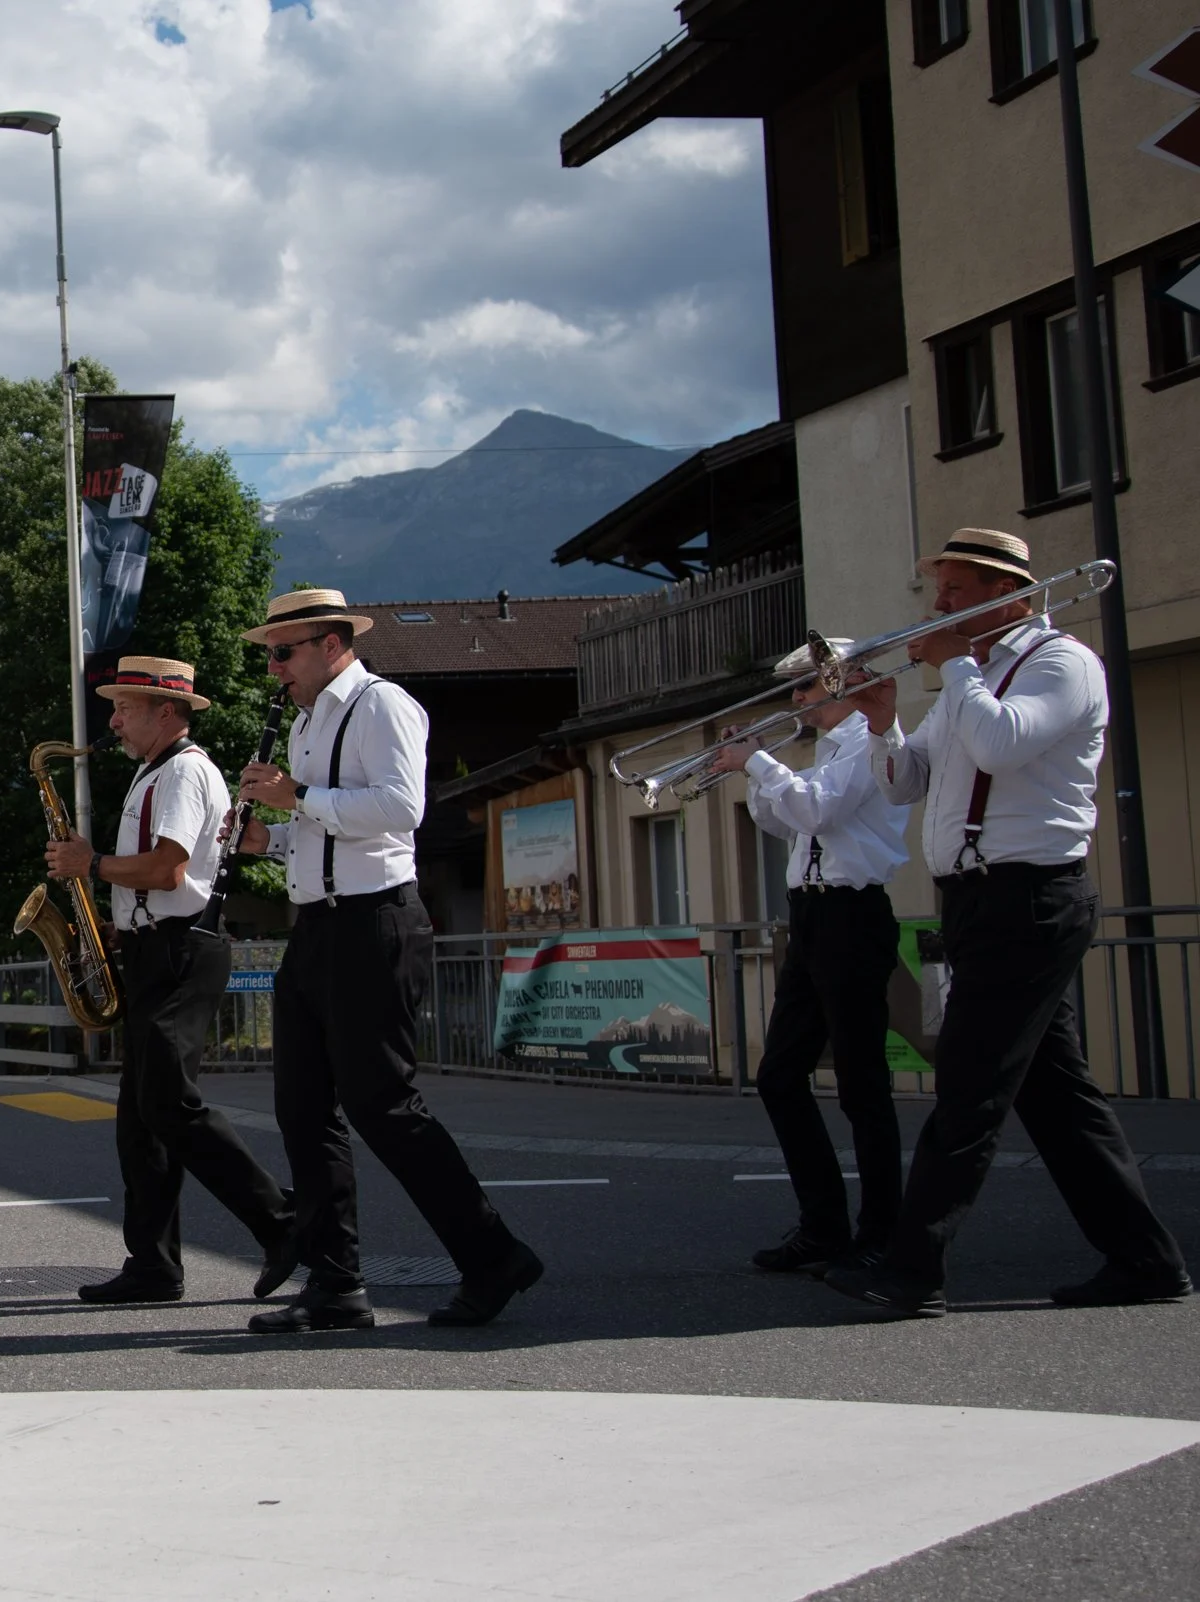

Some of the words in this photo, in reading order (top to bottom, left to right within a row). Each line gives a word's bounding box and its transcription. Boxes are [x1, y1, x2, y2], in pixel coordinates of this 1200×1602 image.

[82, 467, 125, 497] JAZZ
[226, 973, 274, 988] berriedst
[584, 979, 644, 999] PHENOMDEN
[565, 1005, 602, 1020] ORCHESTRA
